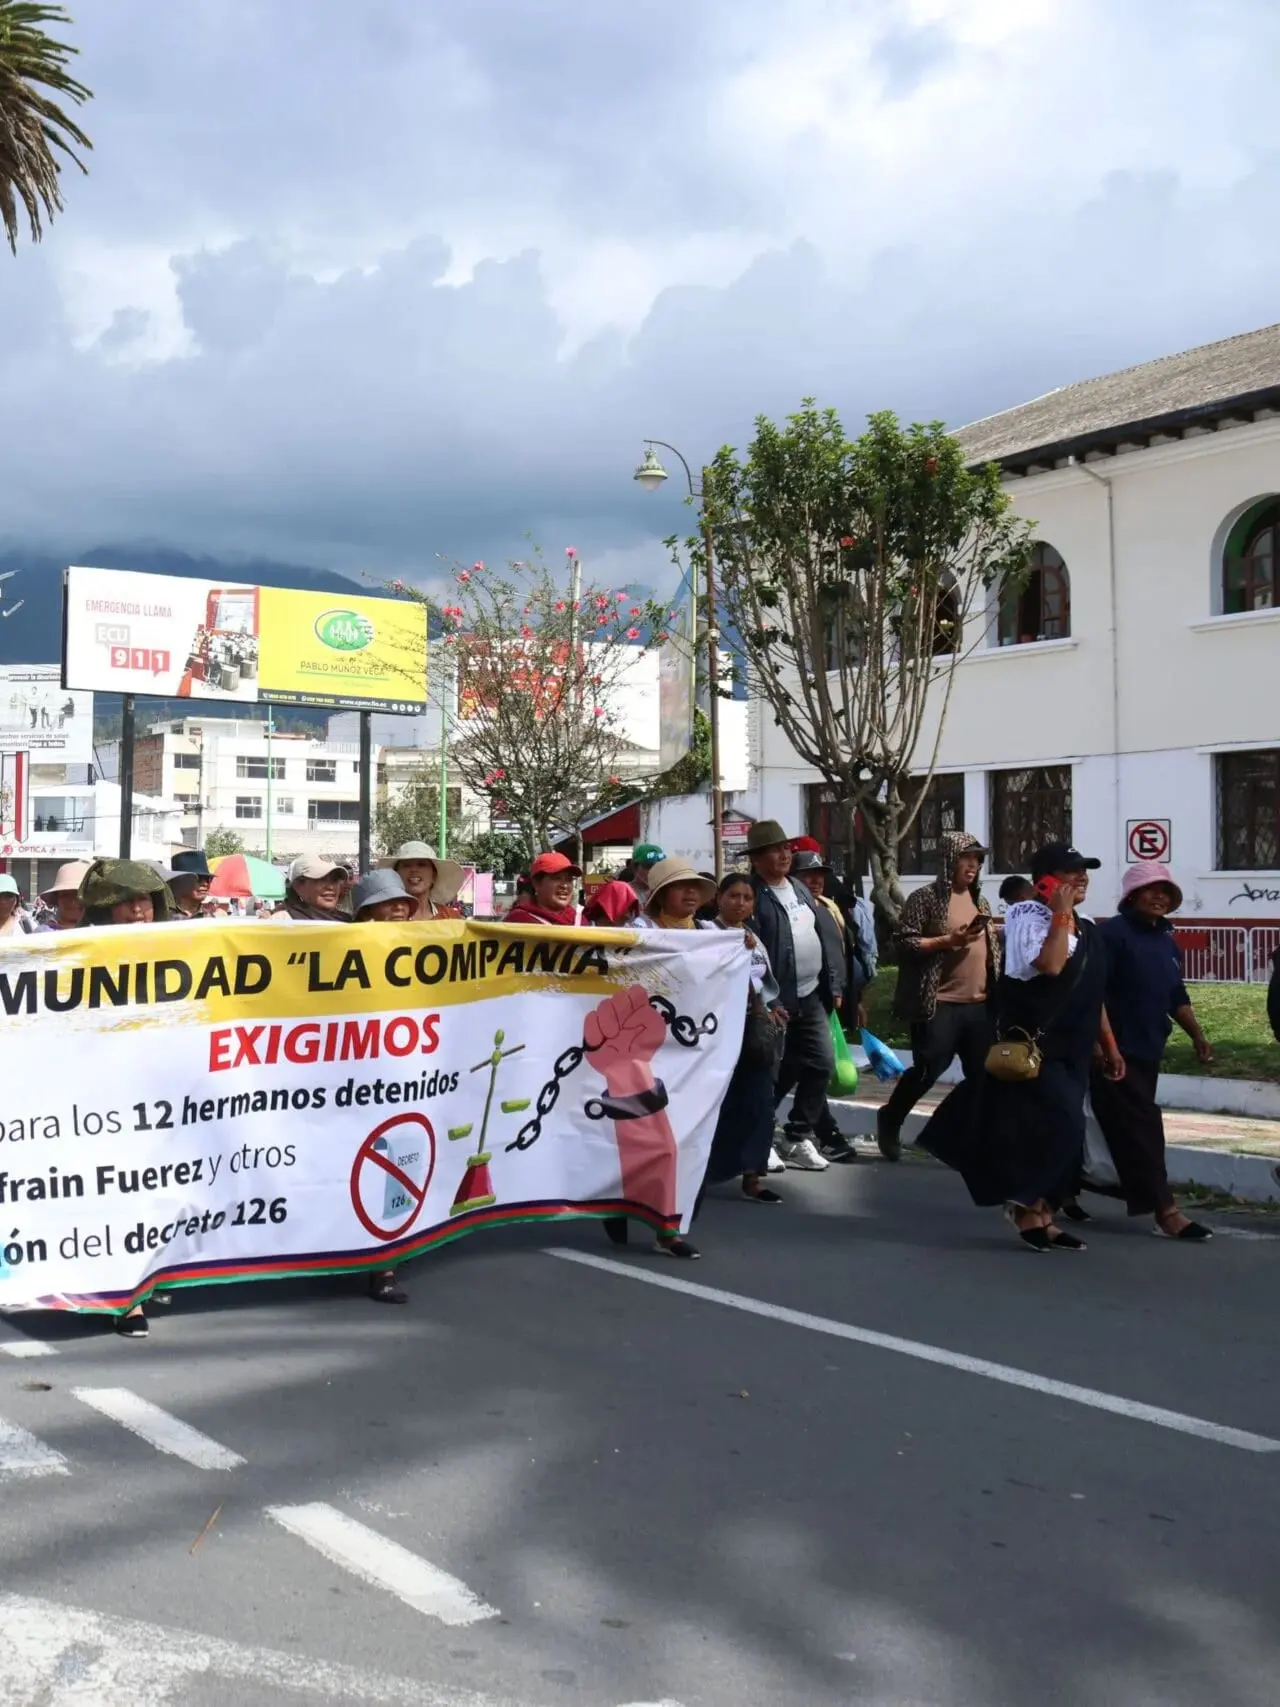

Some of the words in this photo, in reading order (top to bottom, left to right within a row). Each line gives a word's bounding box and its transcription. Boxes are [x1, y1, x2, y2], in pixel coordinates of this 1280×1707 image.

[85, 599, 141, 615] EMERGENCIA
[143, 603, 172, 617] LLAMA
[97, 624, 129, 643] ECU
[113, 646, 167, 670] 911
[300, 660, 328, 672] PABLO
[208, 1013, 441, 1073] EXIGIMOS
[73, 1104, 122, 1137] los
[133, 1100, 174, 1131] 12
[181, 1086, 327, 1126] hermanos
[335, 1068, 460, 1109] detenidos
[96, 1158, 203, 1196] Fuerez
[207, 1154, 222, 1186] y
[229, 1142, 297, 1173] otros
[391, 1194, 406, 1209] 126
[59, 1225, 113, 1260] del
[124, 1209, 227, 1255] decreto
[230, 1197, 288, 1227] 126
